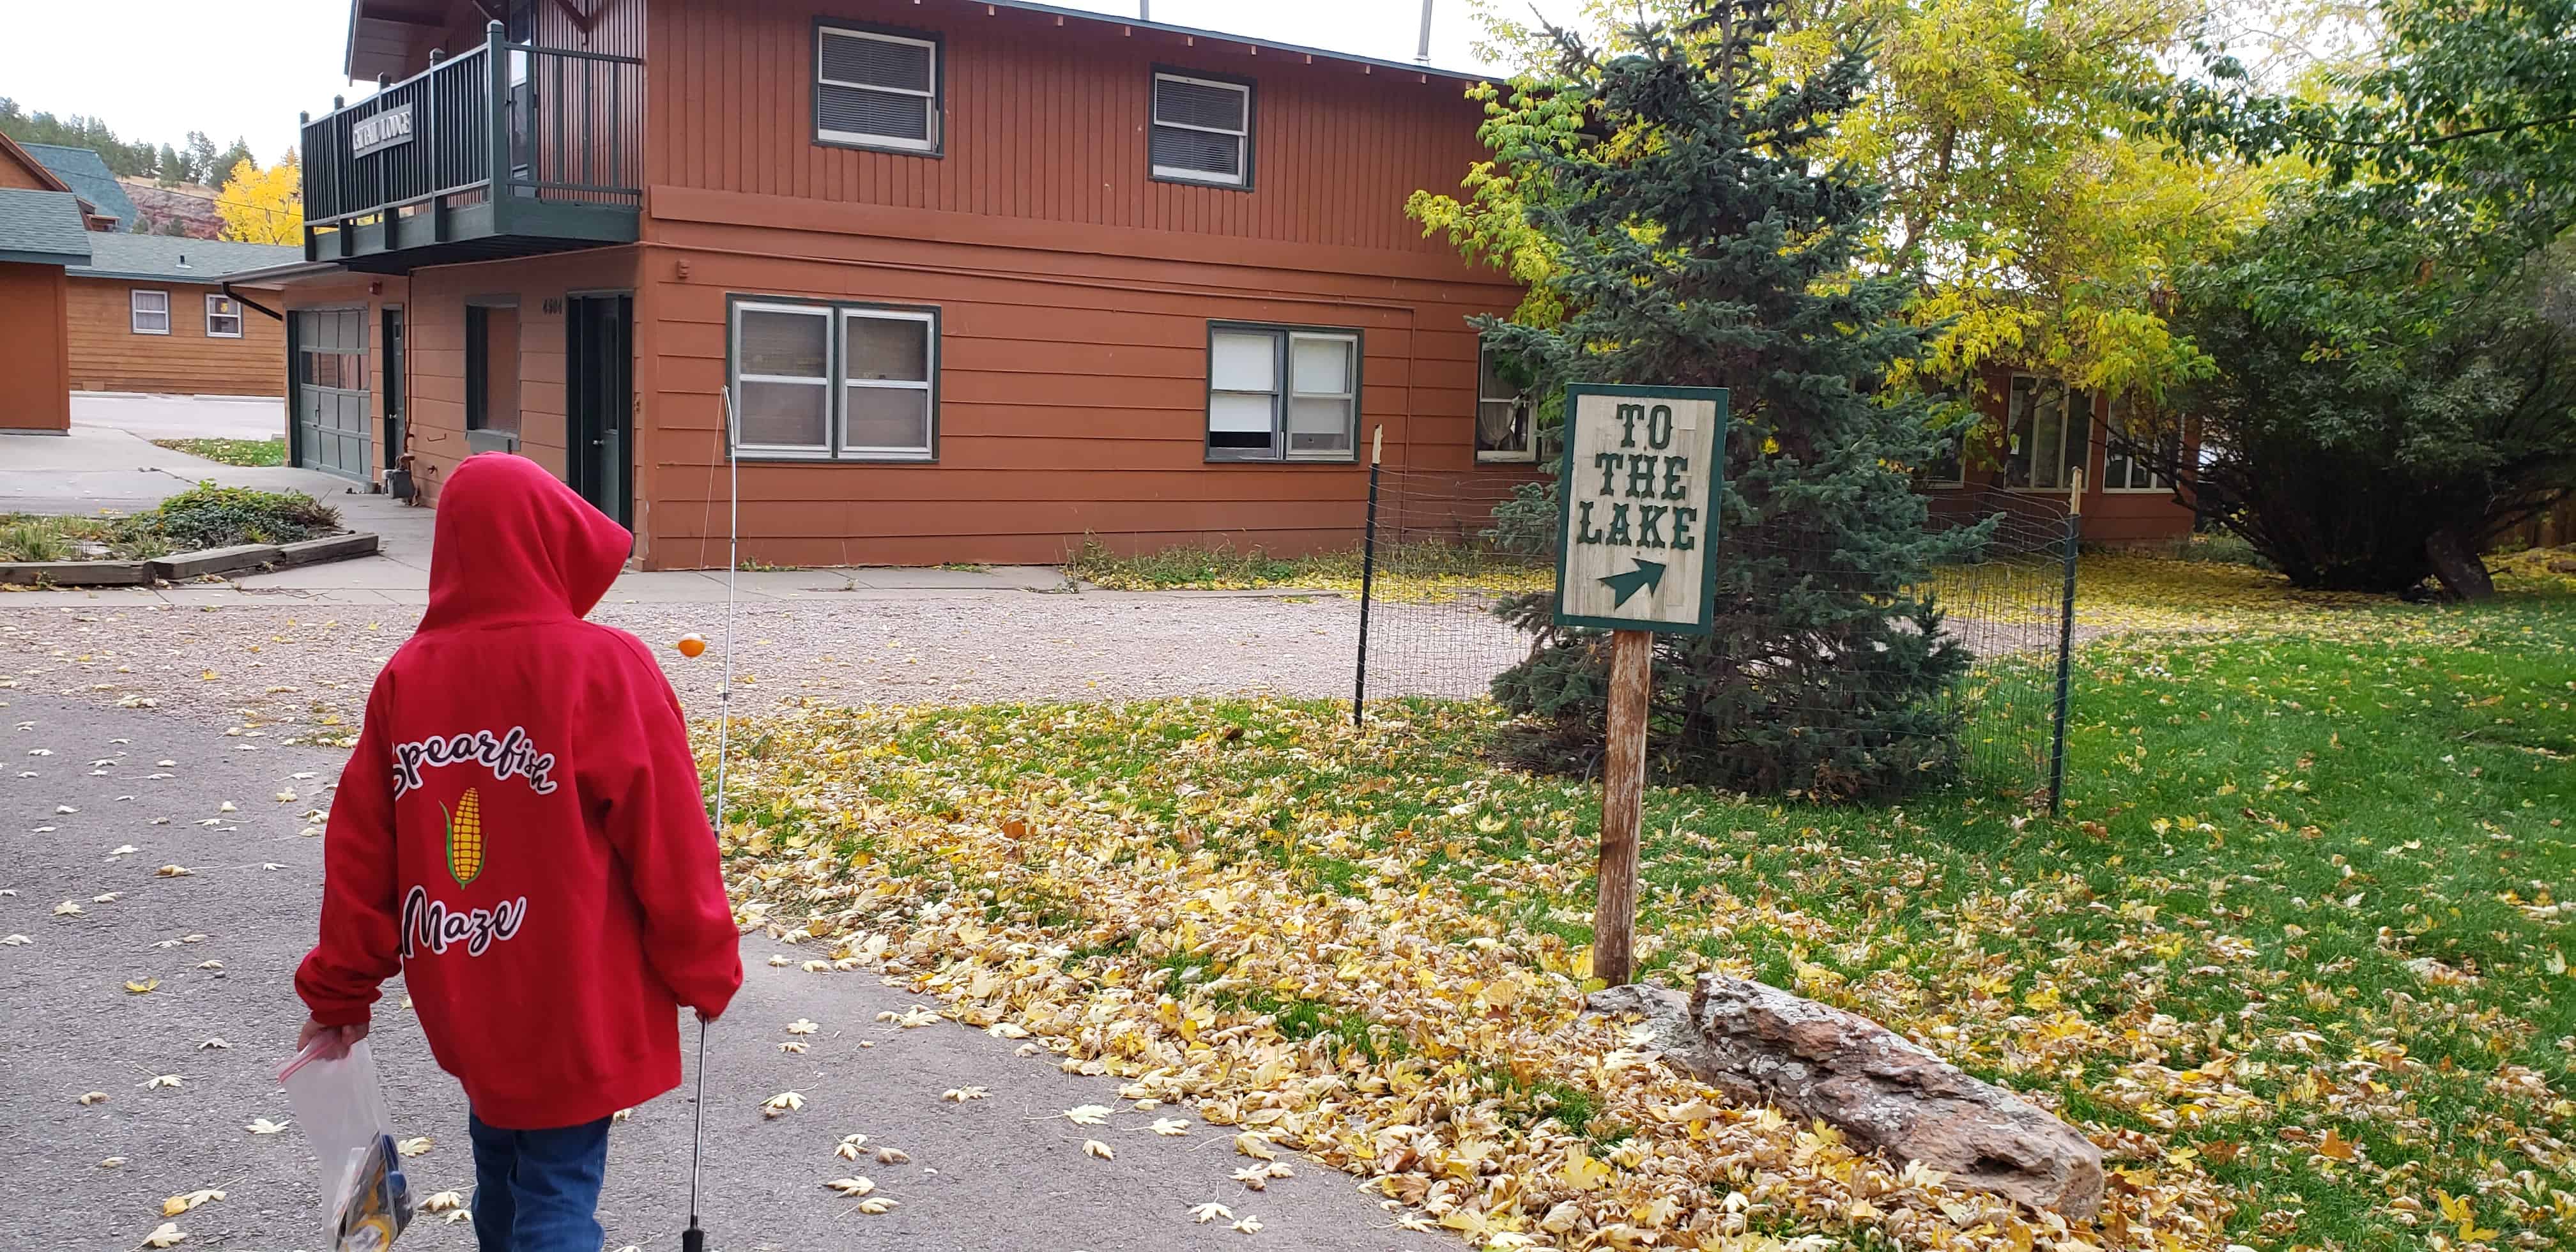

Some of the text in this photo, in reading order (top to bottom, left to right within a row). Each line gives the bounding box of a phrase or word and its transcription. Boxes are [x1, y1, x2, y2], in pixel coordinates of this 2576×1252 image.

[381, 111, 410, 140] LODGE
[1616, 403, 1673, 450] TO
[1595, 452, 1688, 501] THE
[1578, 500, 1697, 551] LAKE
[402, 885, 526, 959] Maze
